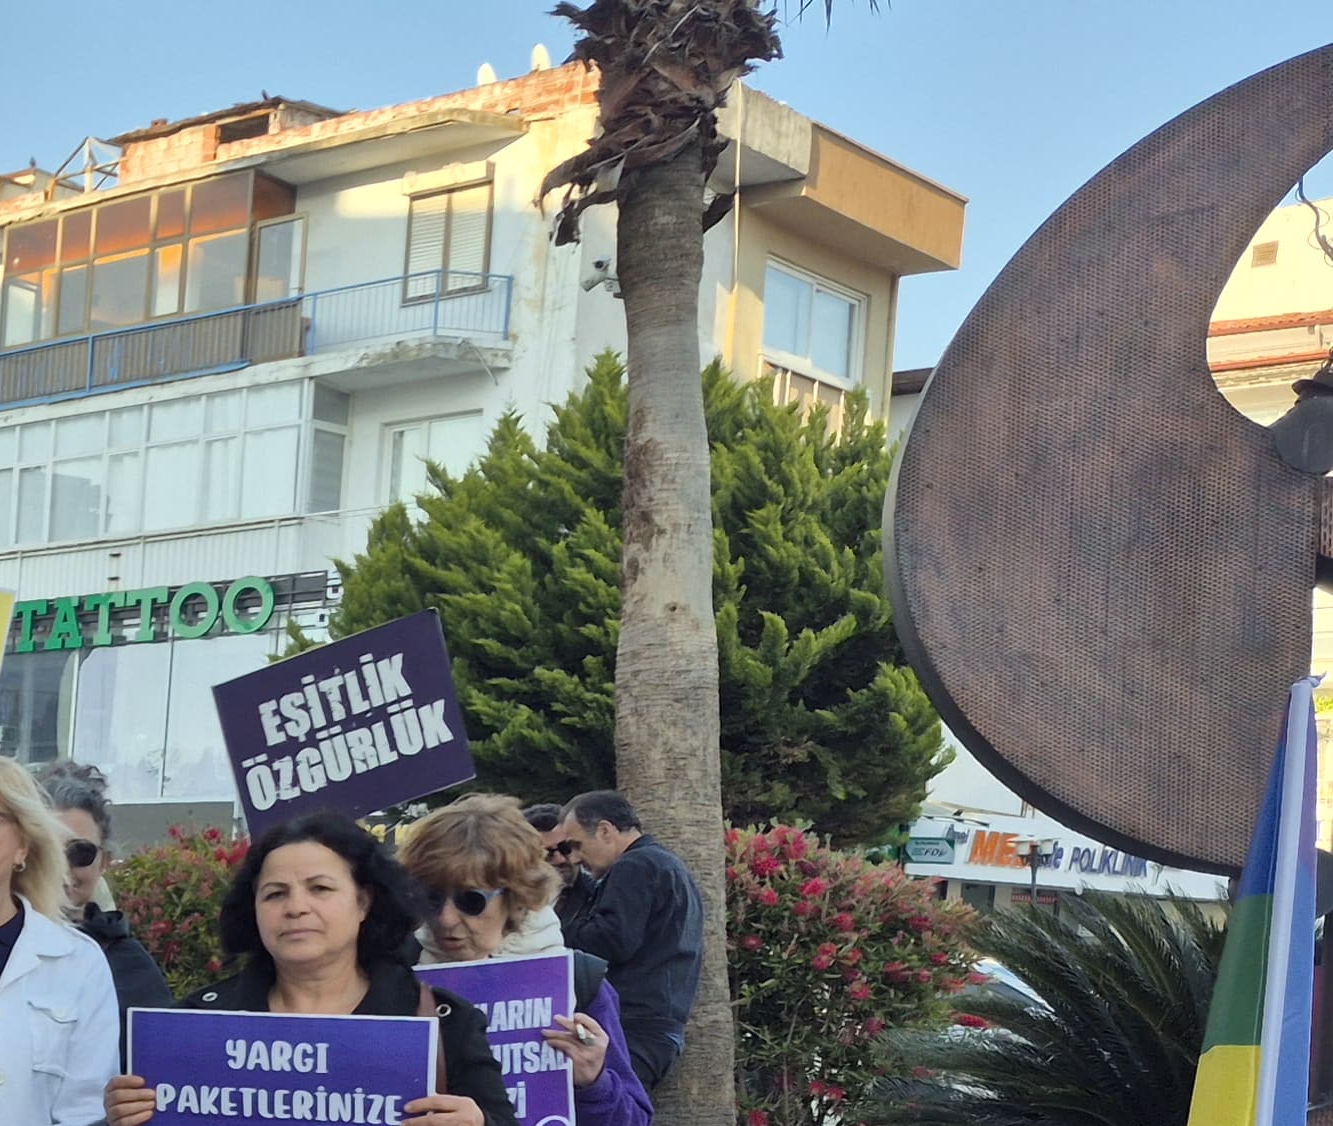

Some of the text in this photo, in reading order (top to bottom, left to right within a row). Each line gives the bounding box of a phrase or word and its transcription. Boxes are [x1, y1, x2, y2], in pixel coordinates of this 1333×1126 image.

[13, 575, 275, 653] TATTOO
[258, 653, 413, 747] EŞİTLİK
[241, 699, 454, 811] ÖZGÜRLÜK
[224, 1038, 330, 1074] YARGI
[154, 1082, 404, 1126] PAKETLERİNİZE
